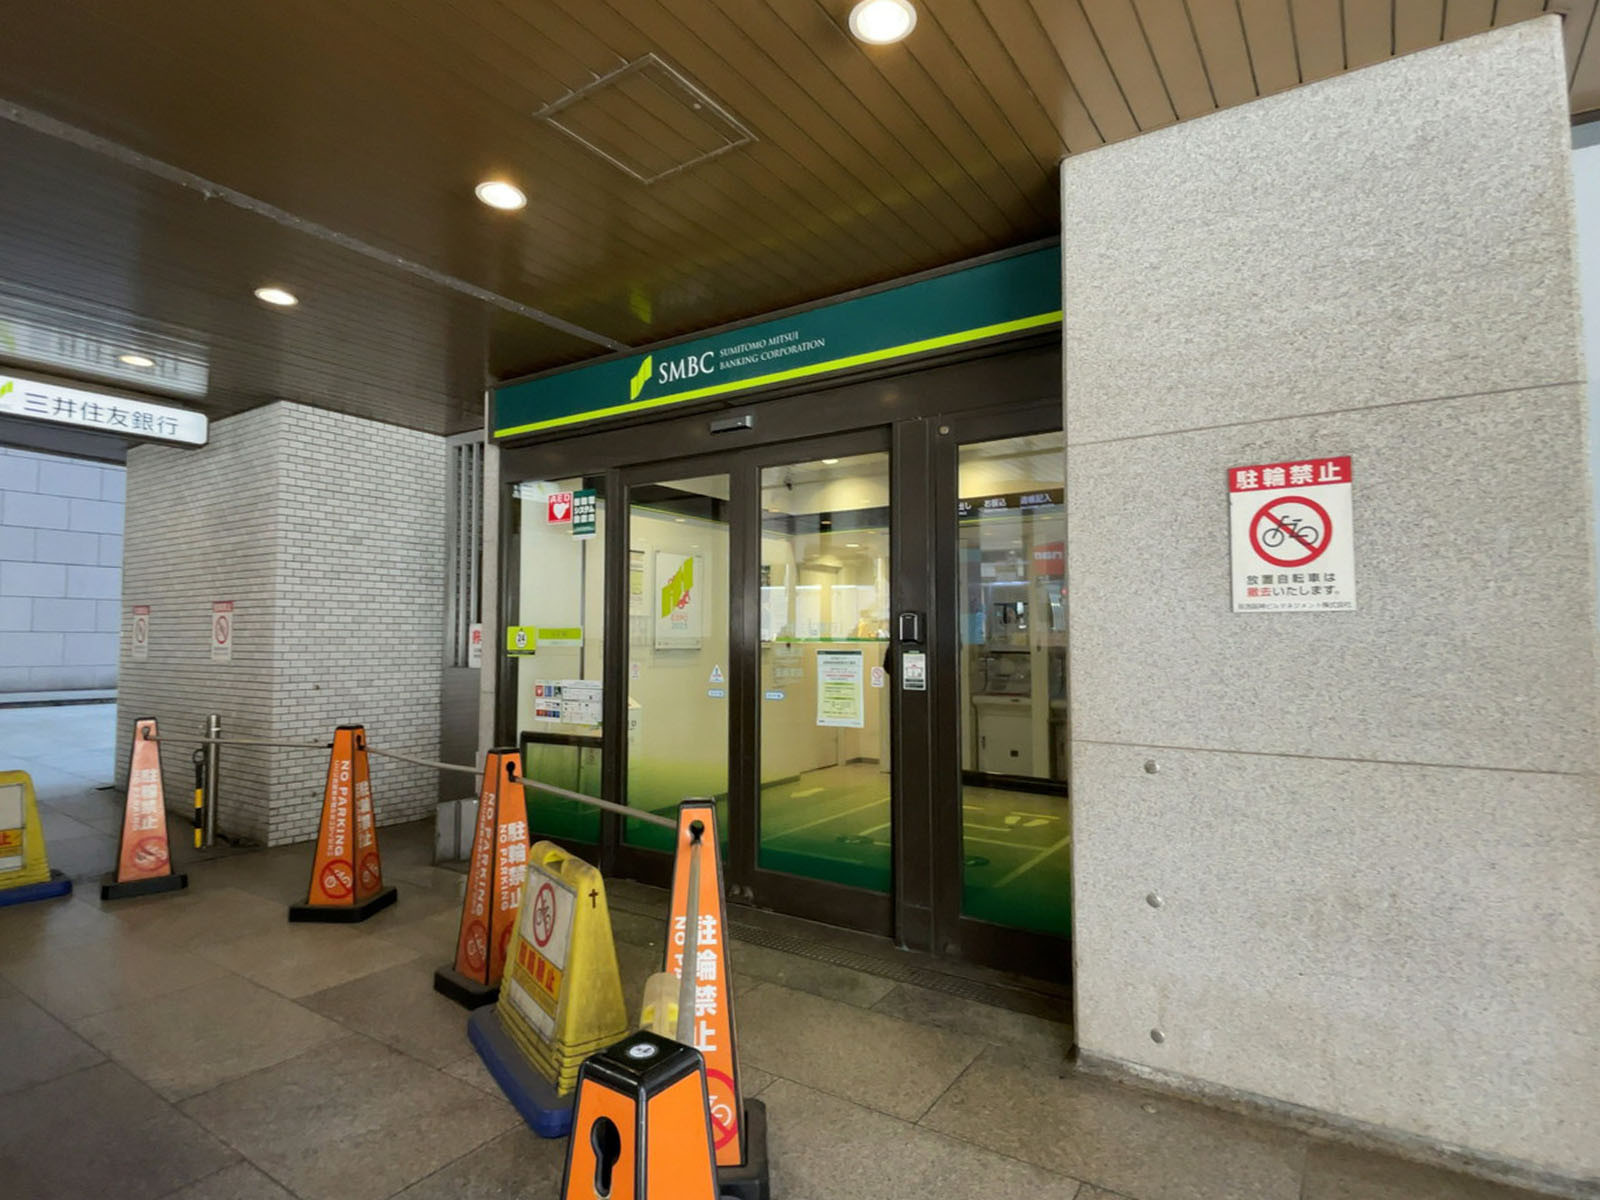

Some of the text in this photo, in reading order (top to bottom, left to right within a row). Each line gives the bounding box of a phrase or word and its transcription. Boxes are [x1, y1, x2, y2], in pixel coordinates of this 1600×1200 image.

[719, 331, 799, 358] SUMITOMO MITSUI
[719, 338, 826, 370] BANKING CORPORATION
[658, 351, 715, 384] SMBC
[24, 391, 179, 436] 三井住友銀行
[1235, 461, 1343, 490] 駐輪禁止
[550, 494, 570, 503] AED
[1246, 573, 1336, 585] 放置自転車は
[335, 760, 350, 857] NO PARKING
[487, 793, 496, 820] NO
[475, 827, 492, 916] PARKING
[500, 824, 510, 911] NO PARKING
